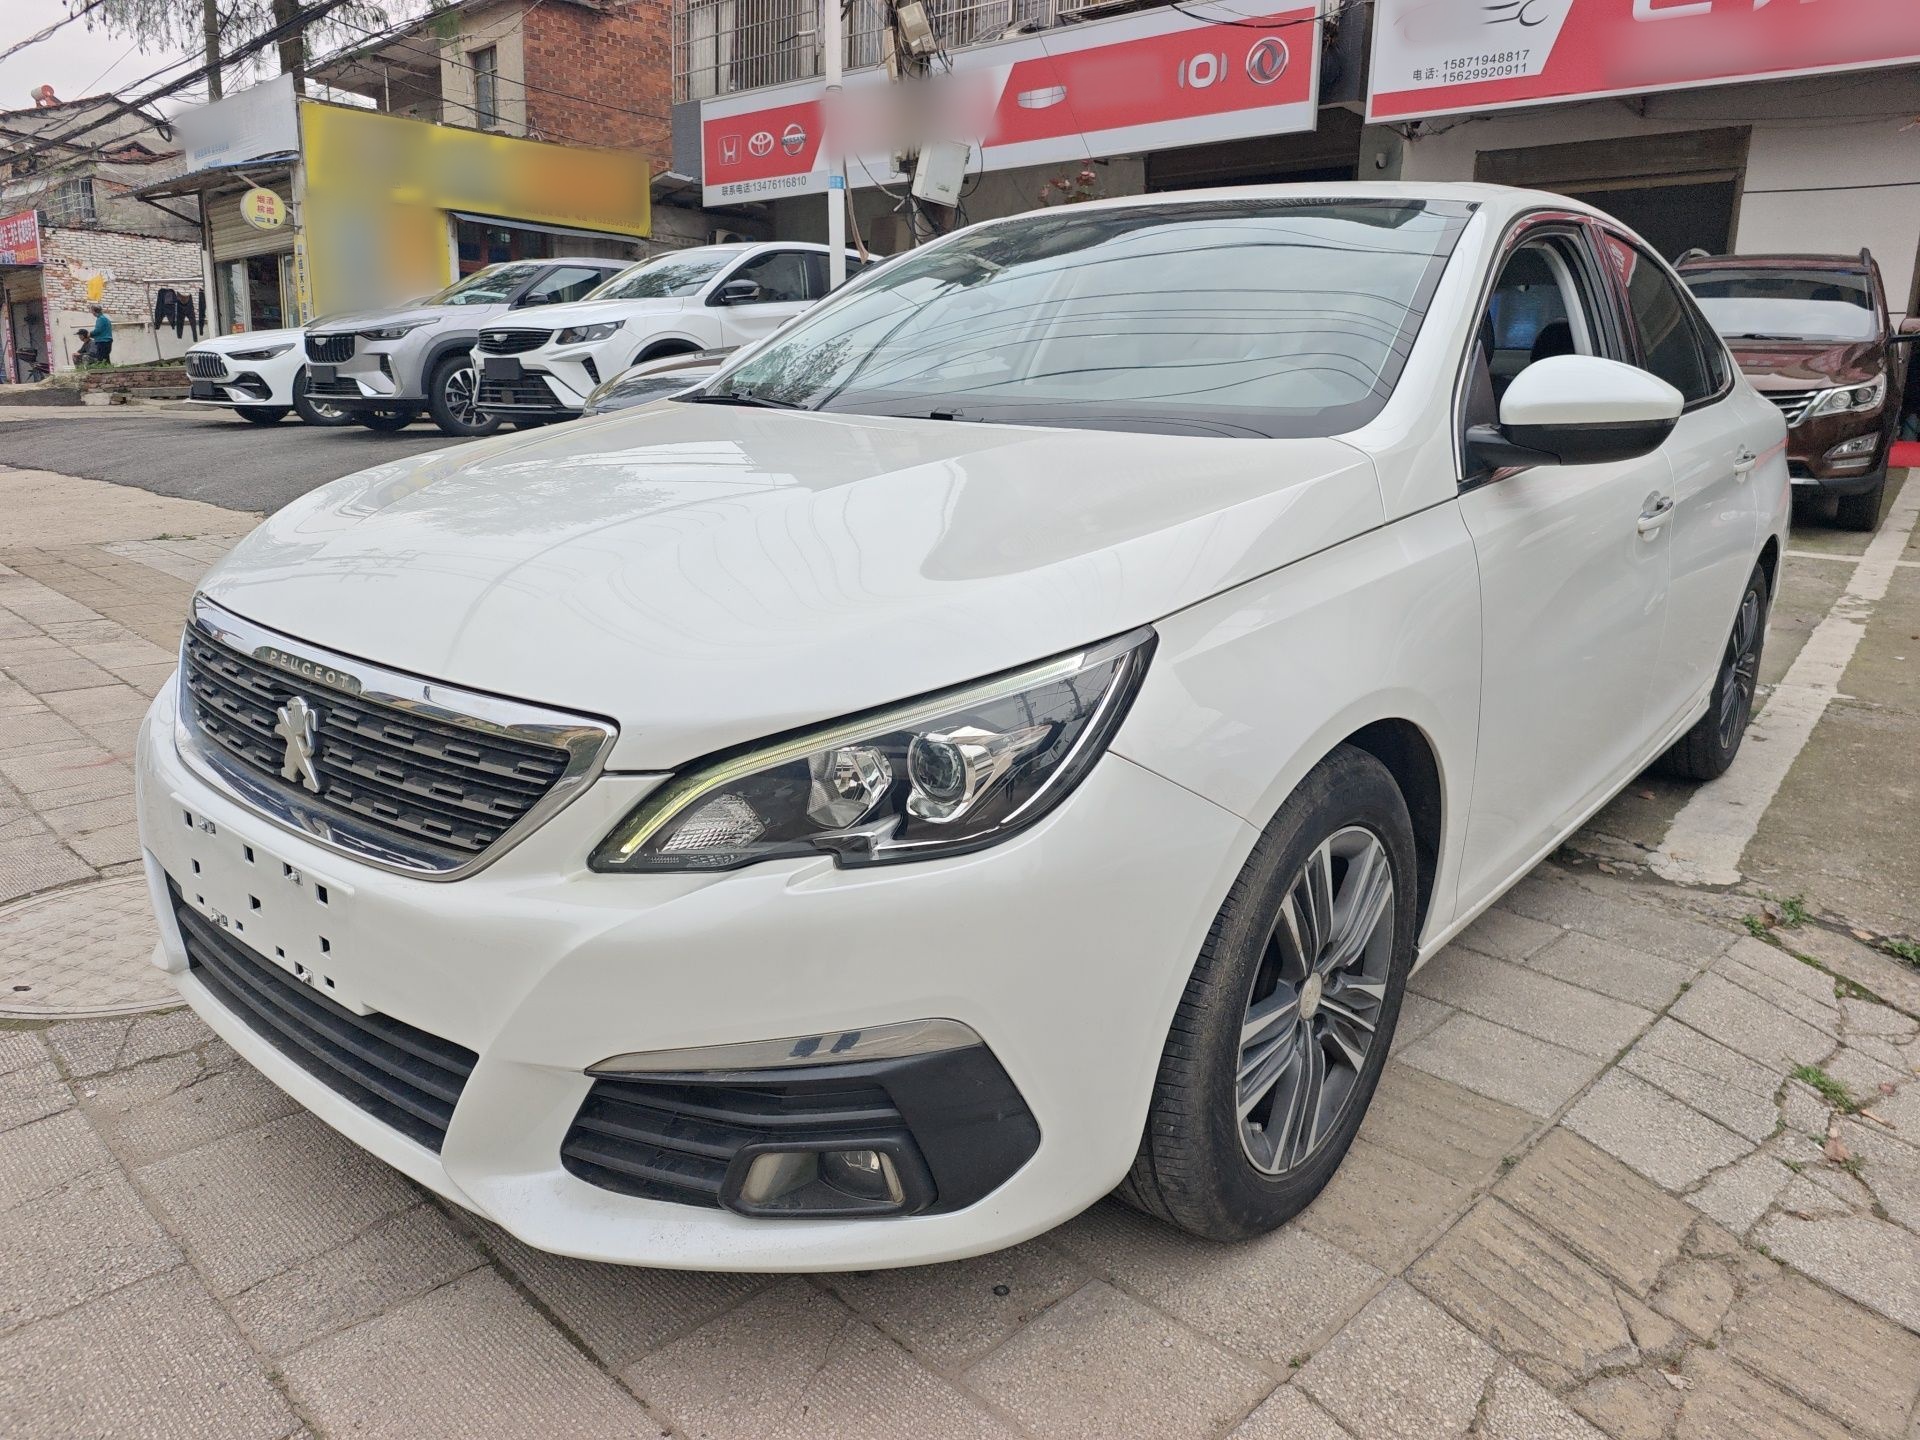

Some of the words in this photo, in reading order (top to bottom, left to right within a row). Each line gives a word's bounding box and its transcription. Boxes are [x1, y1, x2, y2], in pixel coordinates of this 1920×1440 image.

[1443, 49, 1530, 70] 15871948817
[1442, 62, 1527, 83] 15629920911
[269, 651, 349, 688] PEUGEOT
